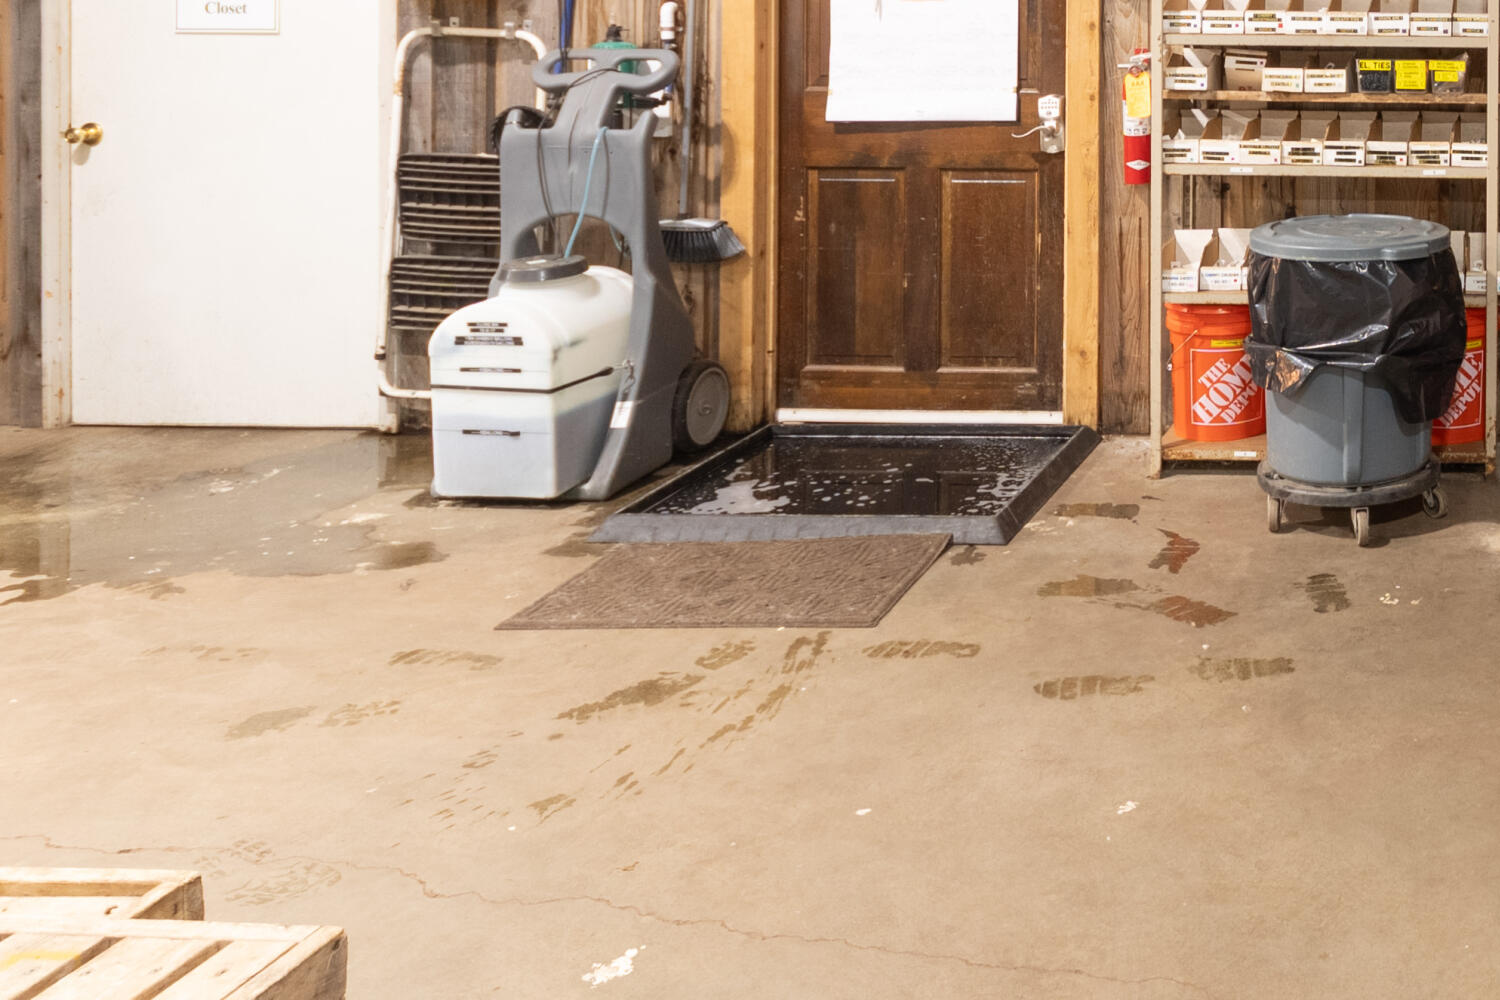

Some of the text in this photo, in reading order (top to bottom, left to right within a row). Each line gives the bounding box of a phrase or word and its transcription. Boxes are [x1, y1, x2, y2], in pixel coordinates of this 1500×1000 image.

[204, 1, 247, 14] Closet
[1193, 353, 1253, 424] HOM
[1198, 357, 1231, 388] THE
[1220, 381, 1258, 424] DEPO
